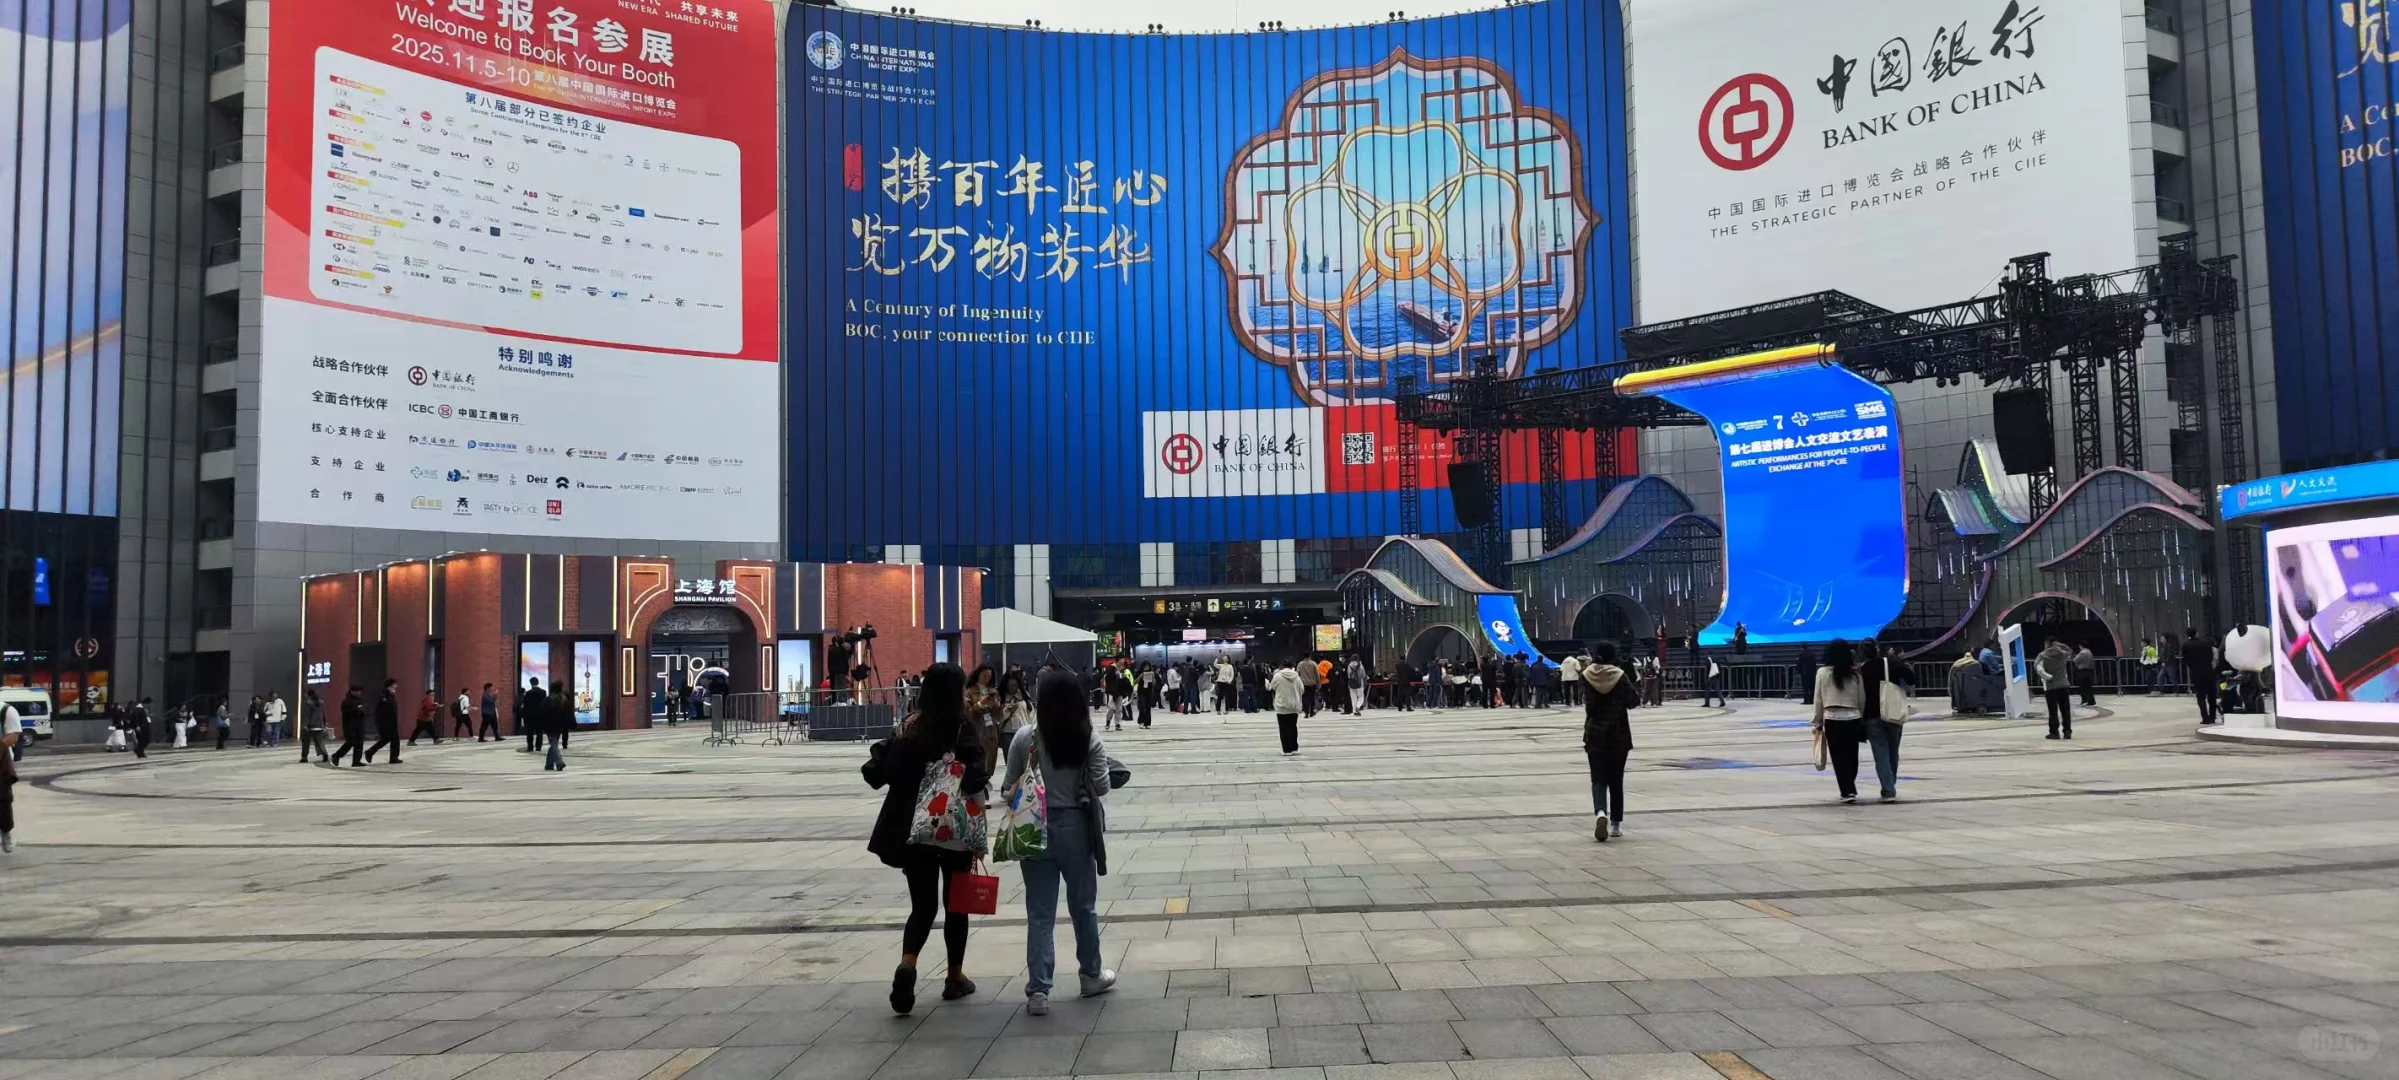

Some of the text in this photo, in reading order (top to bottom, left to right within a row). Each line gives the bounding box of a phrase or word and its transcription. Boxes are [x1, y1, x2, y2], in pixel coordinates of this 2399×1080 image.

[618, 1, 639, 11] NEW
[640, 5, 659, 16] ERA
[665, 10, 701, 25] SHARED
[703, 19, 739, 33] FUTURE
[681, 1, 739, 23] 共享未来
[423, 0, 674, 67] 迎报名参展
[395, 2, 675, 89] Welcome to Book Your Booth
[850, 42, 935, 61] 中国国际进口博览会
[391, 33, 531, 87] 2025.11.5-10
[534, 69, 677, 110] 第八届中国国际进口博览会
[811, 85, 824, 94] THE
[866, 92, 896, 103] PARNER
[465, 91, 607, 134] 第八届部分已签约企业
[579, 94, 630, 110] INTERNATIONAL
[632, 104, 657, 115] IMPORT
[658, 109, 676, 119] EXPO
[1822, 71, 2048, 150] BANK OF CHINA
[525, 119, 559, 133] Enterprises
[560, 127, 570, 135] for
[570, 129, 580, 137] the
[2339, 114, 2356, 134] A
[1708, 129, 2048, 221] 中国国际进口博览会战略合作伙伴
[523, 190, 538, 199] ABB
[1710, 153, 2049, 239] THE STRATEGIC PARTNER OF THE CIIE
[442, 276, 457, 285] SGS
[845, 298, 1045, 324] A Century of Ingenuity
[845, 322, 1096, 346] BOC, your connection to CIIE
[312, 355, 389, 378] 战略合作伙伴
[498, 346, 573, 369] 特别鸣谢
[498, 363, 575, 379] Acknowledgements
[311, 389, 388, 411] 全面合作伙伴
[408, 403, 434, 414] ICBC
[1855, 403, 1887, 416] SMG
[458, 407, 520, 423] 中国工商银行
[1772, 415, 1784, 430] 7
[311, 422, 387, 441] 核心支持企业
[310, 455, 386, 472] 支持企业
[1731, 443, 1887, 469] ARTISTIC PERFORMANCES FOR PEOPLE-TO-PEOPLE
[1213, 461, 1306, 473] BANK OF CHINA
[1768, 462, 1803, 474] EXCHANGE
[1804, 461, 1812, 469] AT
[1812, 460, 1826, 468] THE
[309, 488, 386, 503] 合作商
[483, 503, 502, 513] TASTY
[503, 505, 511, 514] by
[674, 579, 737, 595] 上海馆
[1168, 602, 1175, 612] 3
[1254, 600, 1261, 609] 2
